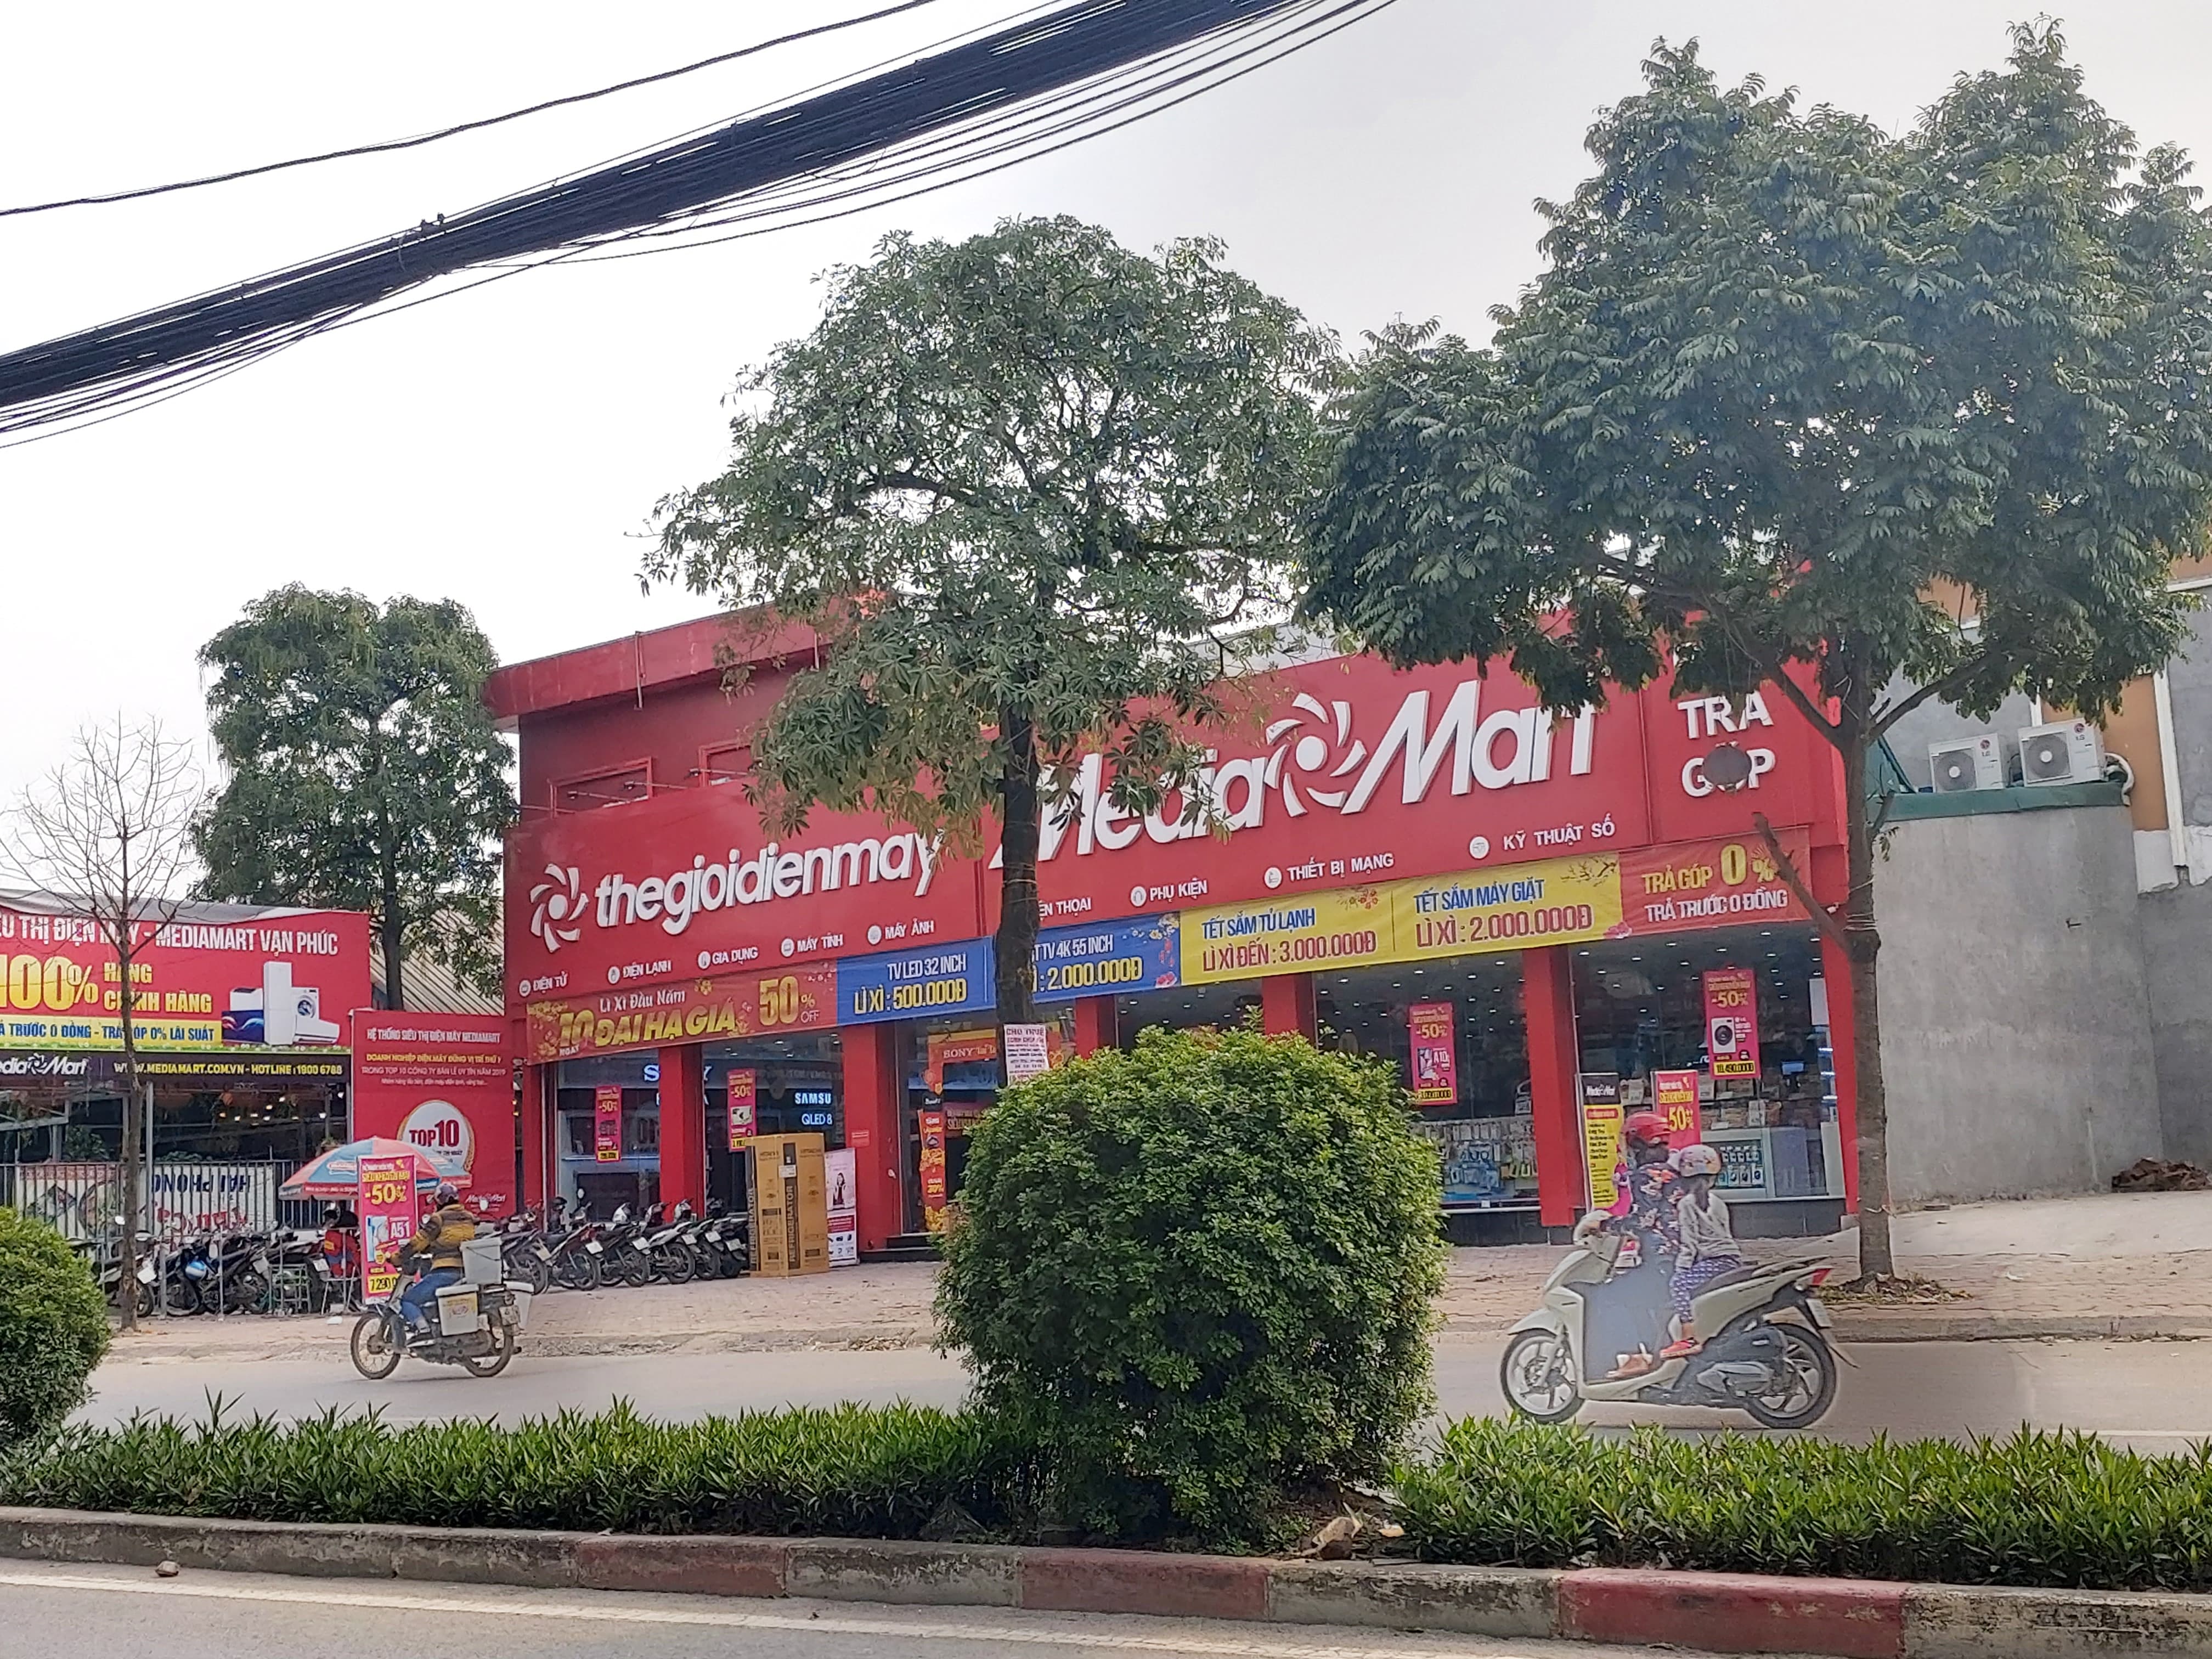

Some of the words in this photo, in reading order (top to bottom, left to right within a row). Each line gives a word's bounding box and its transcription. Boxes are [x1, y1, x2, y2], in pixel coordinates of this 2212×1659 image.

[1340, 679, 1599, 814] Mart
[1681, 741, 1776, 798] GP
[1503, 828, 1527, 851] KỸ
[1534, 823, 1584, 847] THUẬT
[1590, 813, 1616, 839] SỐ
[1286, 856, 1326, 882] THIẾT
[1330, 859, 1345, 878] BỊ
[1351, 852, 1395, 874] MẠNG
[1641, 864, 1677, 895] TRẢ
[1678, 865, 1714, 890] GÓP
[596, 828, 946, 935] thegioidienmay
[1149, 885, 1175, 902] PHỤ
[1178, 877, 1208, 900] KIỆN
[1413, 887, 1440, 915] TẾT
[1441, 882, 1475, 911] SẮM
[1476, 881, 1510, 907] MÁY
[1511, 876, 1545, 905] GIẶT
[1039, 900, 1053, 921] ỆN
[1056, 897, 1092, 917] THOẠI
[1644, 896, 1676, 923] TRẢ
[1677, 893, 1728, 919] TRƯỚC
[1742, 885, 1788, 912] ĐỒNG
[19, 916, 49, 945] THỊ
[53, 918, 95, 947] ĐIỆN
[100, 921, 140, 945] MY
[155, 924, 257, 951] MEDIAMART
[260, 929, 294, 957] VẠN
[297, 927, 338, 955] PHÚC
[885, 922, 907, 940] MÁY
[911, 918, 935, 936] ẢNH
[1201, 915, 1225, 940] TẾT
[1227, 911, 1257, 938] SẮM
[1259, 907, 1278, 934] TỦ
[1279, 908, 1316, 934] LẠNH
[1415, 917, 1433, 948] LÌ
[1436, 915, 1457, 946] XÌ
[1469, 903, 1593, 943] 2.000.000Đ
[713, 952, 729, 964] GIA
[731, 946, 759, 966] DỤNG
[797, 935, 818, 952] MÁY
[821, 933, 844, 950] TÍNH
[1041, 942, 1056, 961] TV
[1056, 939, 1071, 958] 4K
[1072, 938, 1087, 957] 55
[1088, 934, 1115, 955] INCH
[1203, 945, 1216, 972] LÌ
[1218, 943, 1235, 970] XÌ
[1236, 936, 1270, 968] ĐẾN
[1279, 929, 1378, 963] 3.000.000Đ
[104, 962, 153, 984] HNG
[623, 962, 644, 979] ĐIỆN
[646, 960, 672, 978] LẠNH
[887, 963, 901, 981] TV
[902, 961, 923, 979] LED
[924, 958, 939, 977] 32
[940, 952, 967, 974] INCH
[1047, 956, 1143, 991] 2.000.000Đ
[533, 976, 553, 994] ĐIỆN
[555, 970, 568, 987] TỬ
[614, 995, 628, 1012] Xì
[630, 990, 654, 1010] Đầu
[656, 989, 686, 1006] Năm
[854, 986, 867, 1015] LÌ
[869, 984, 884, 1013] XÌ
[893, 979, 968, 1011] 500.000Đ
[9, 1020, 47, 1037] TRƯỚC
[61, 1020, 91, 1039] ĐỒNG
[133, 1024, 147, 1040] ÓP
[151, 1026, 167, 1041] 0%
[188, 1024, 214, 1041] SUẤT
[594, 1013, 643, 1048] ĐẠI
[643, 1008, 684, 1042] HẠ
[685, 997, 736, 1036] GIÁ
[800, 1010, 821, 1024] OFF
[44, 1055, 89, 1076] Mart
[943, 1047, 974, 1059] SONY
[802, 1113, 826, 1125] QLED
[409, 1129, 436, 1147] TOP
[390, 1221, 410, 1239] A51
[786, 1185, 797, 1263] REFRIGERATOR
